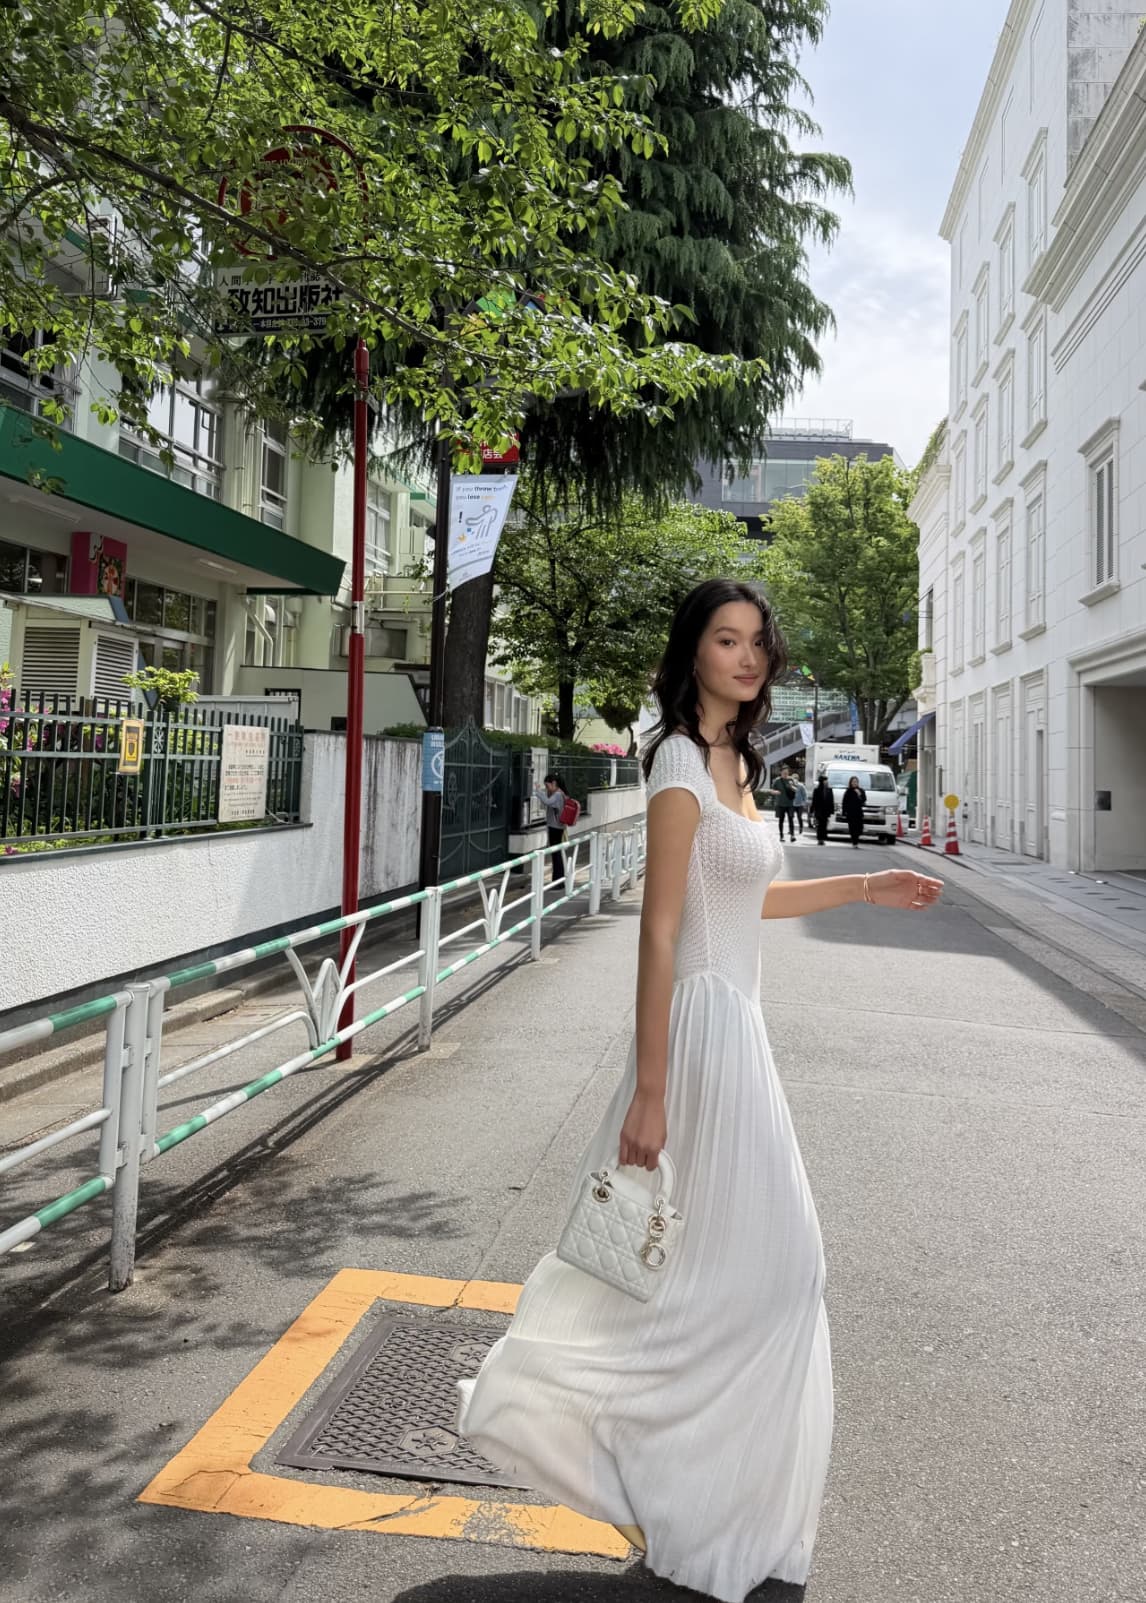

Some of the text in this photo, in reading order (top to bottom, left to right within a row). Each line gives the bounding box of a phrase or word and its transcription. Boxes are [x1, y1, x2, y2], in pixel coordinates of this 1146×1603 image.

[227, 284, 343, 316] 致知出版社
